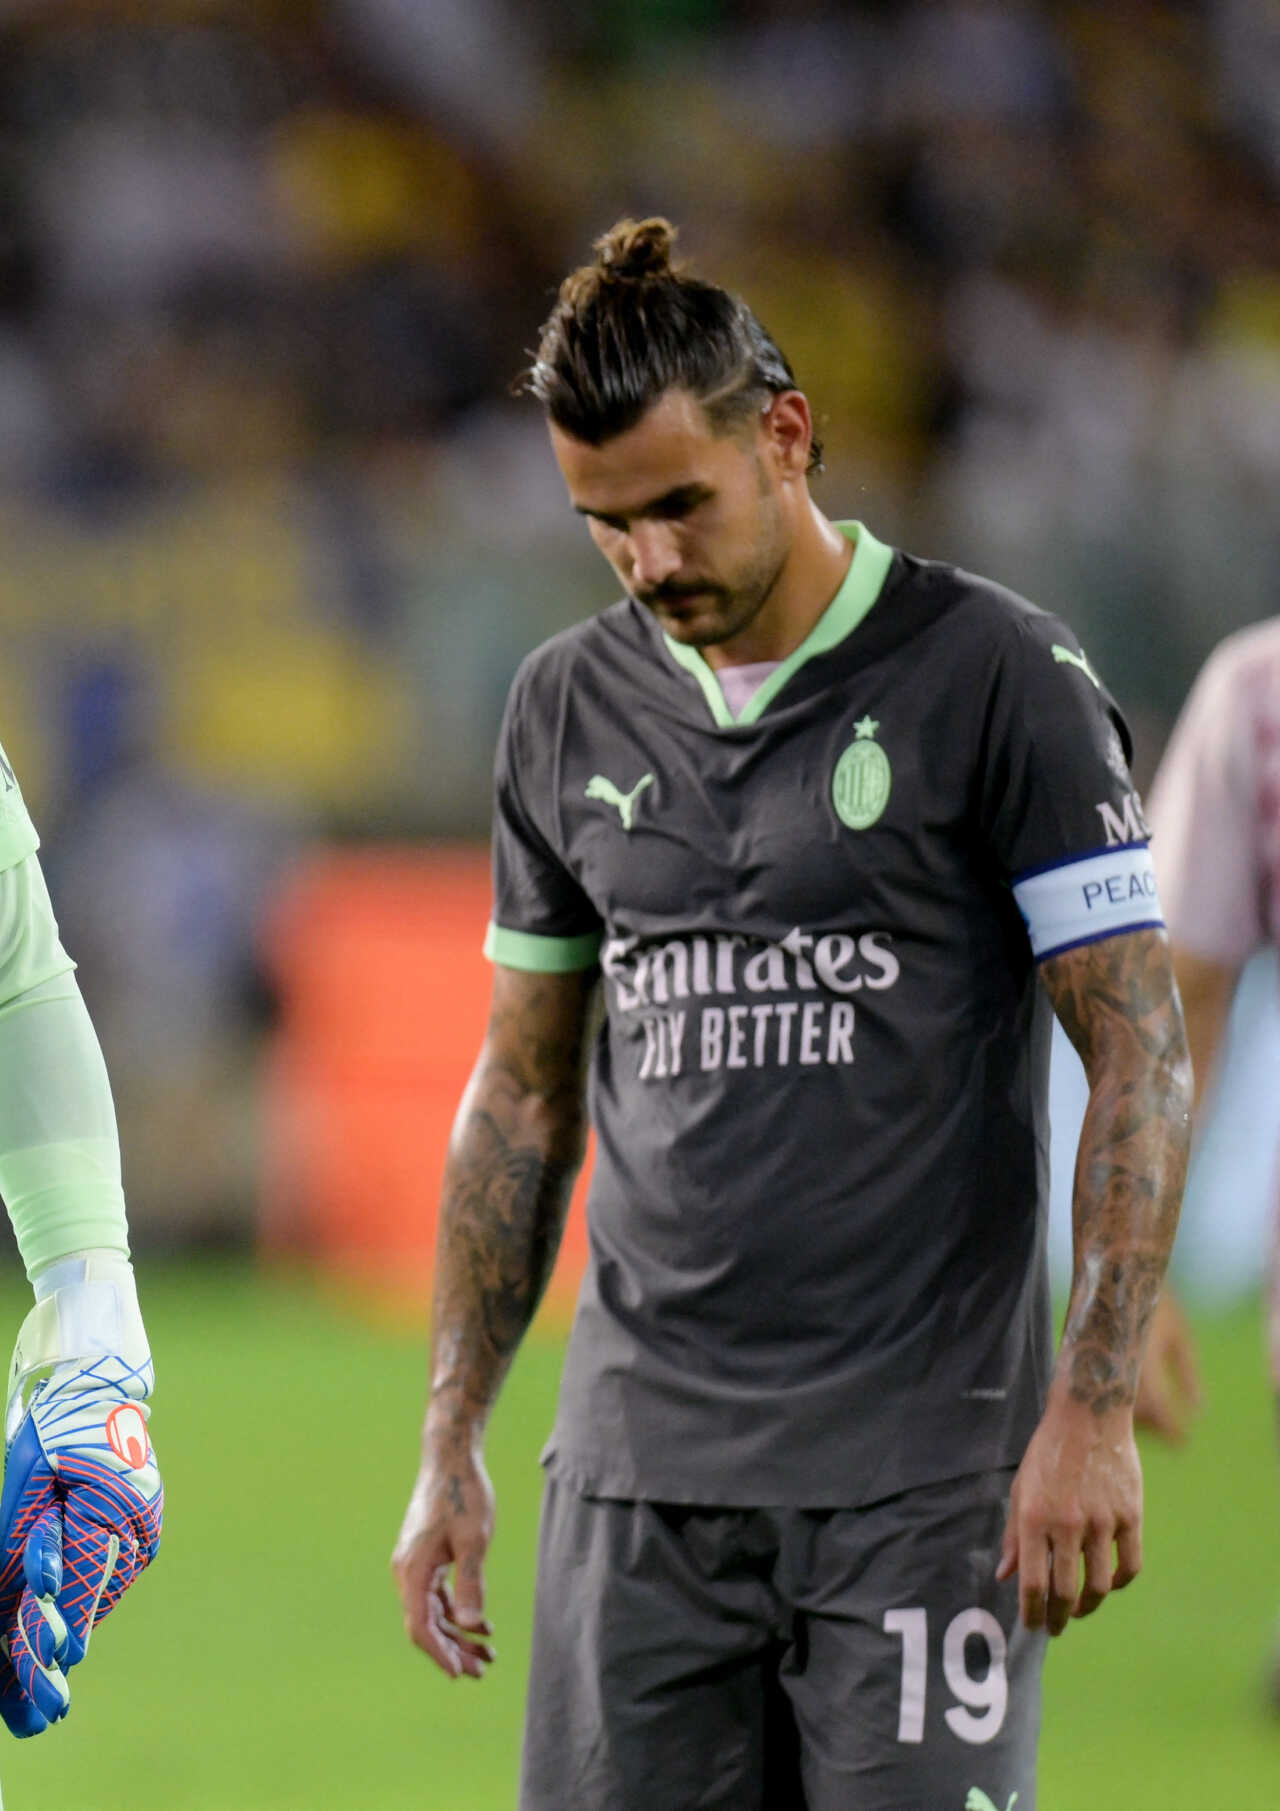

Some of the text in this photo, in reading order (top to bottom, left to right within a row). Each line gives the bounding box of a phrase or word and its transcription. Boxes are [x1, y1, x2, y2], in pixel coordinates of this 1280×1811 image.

[599, 925, 900, 1012] Emirates
[699, 1001, 855, 1072] BETTER
[883, 1607, 1008, 1745] 19
